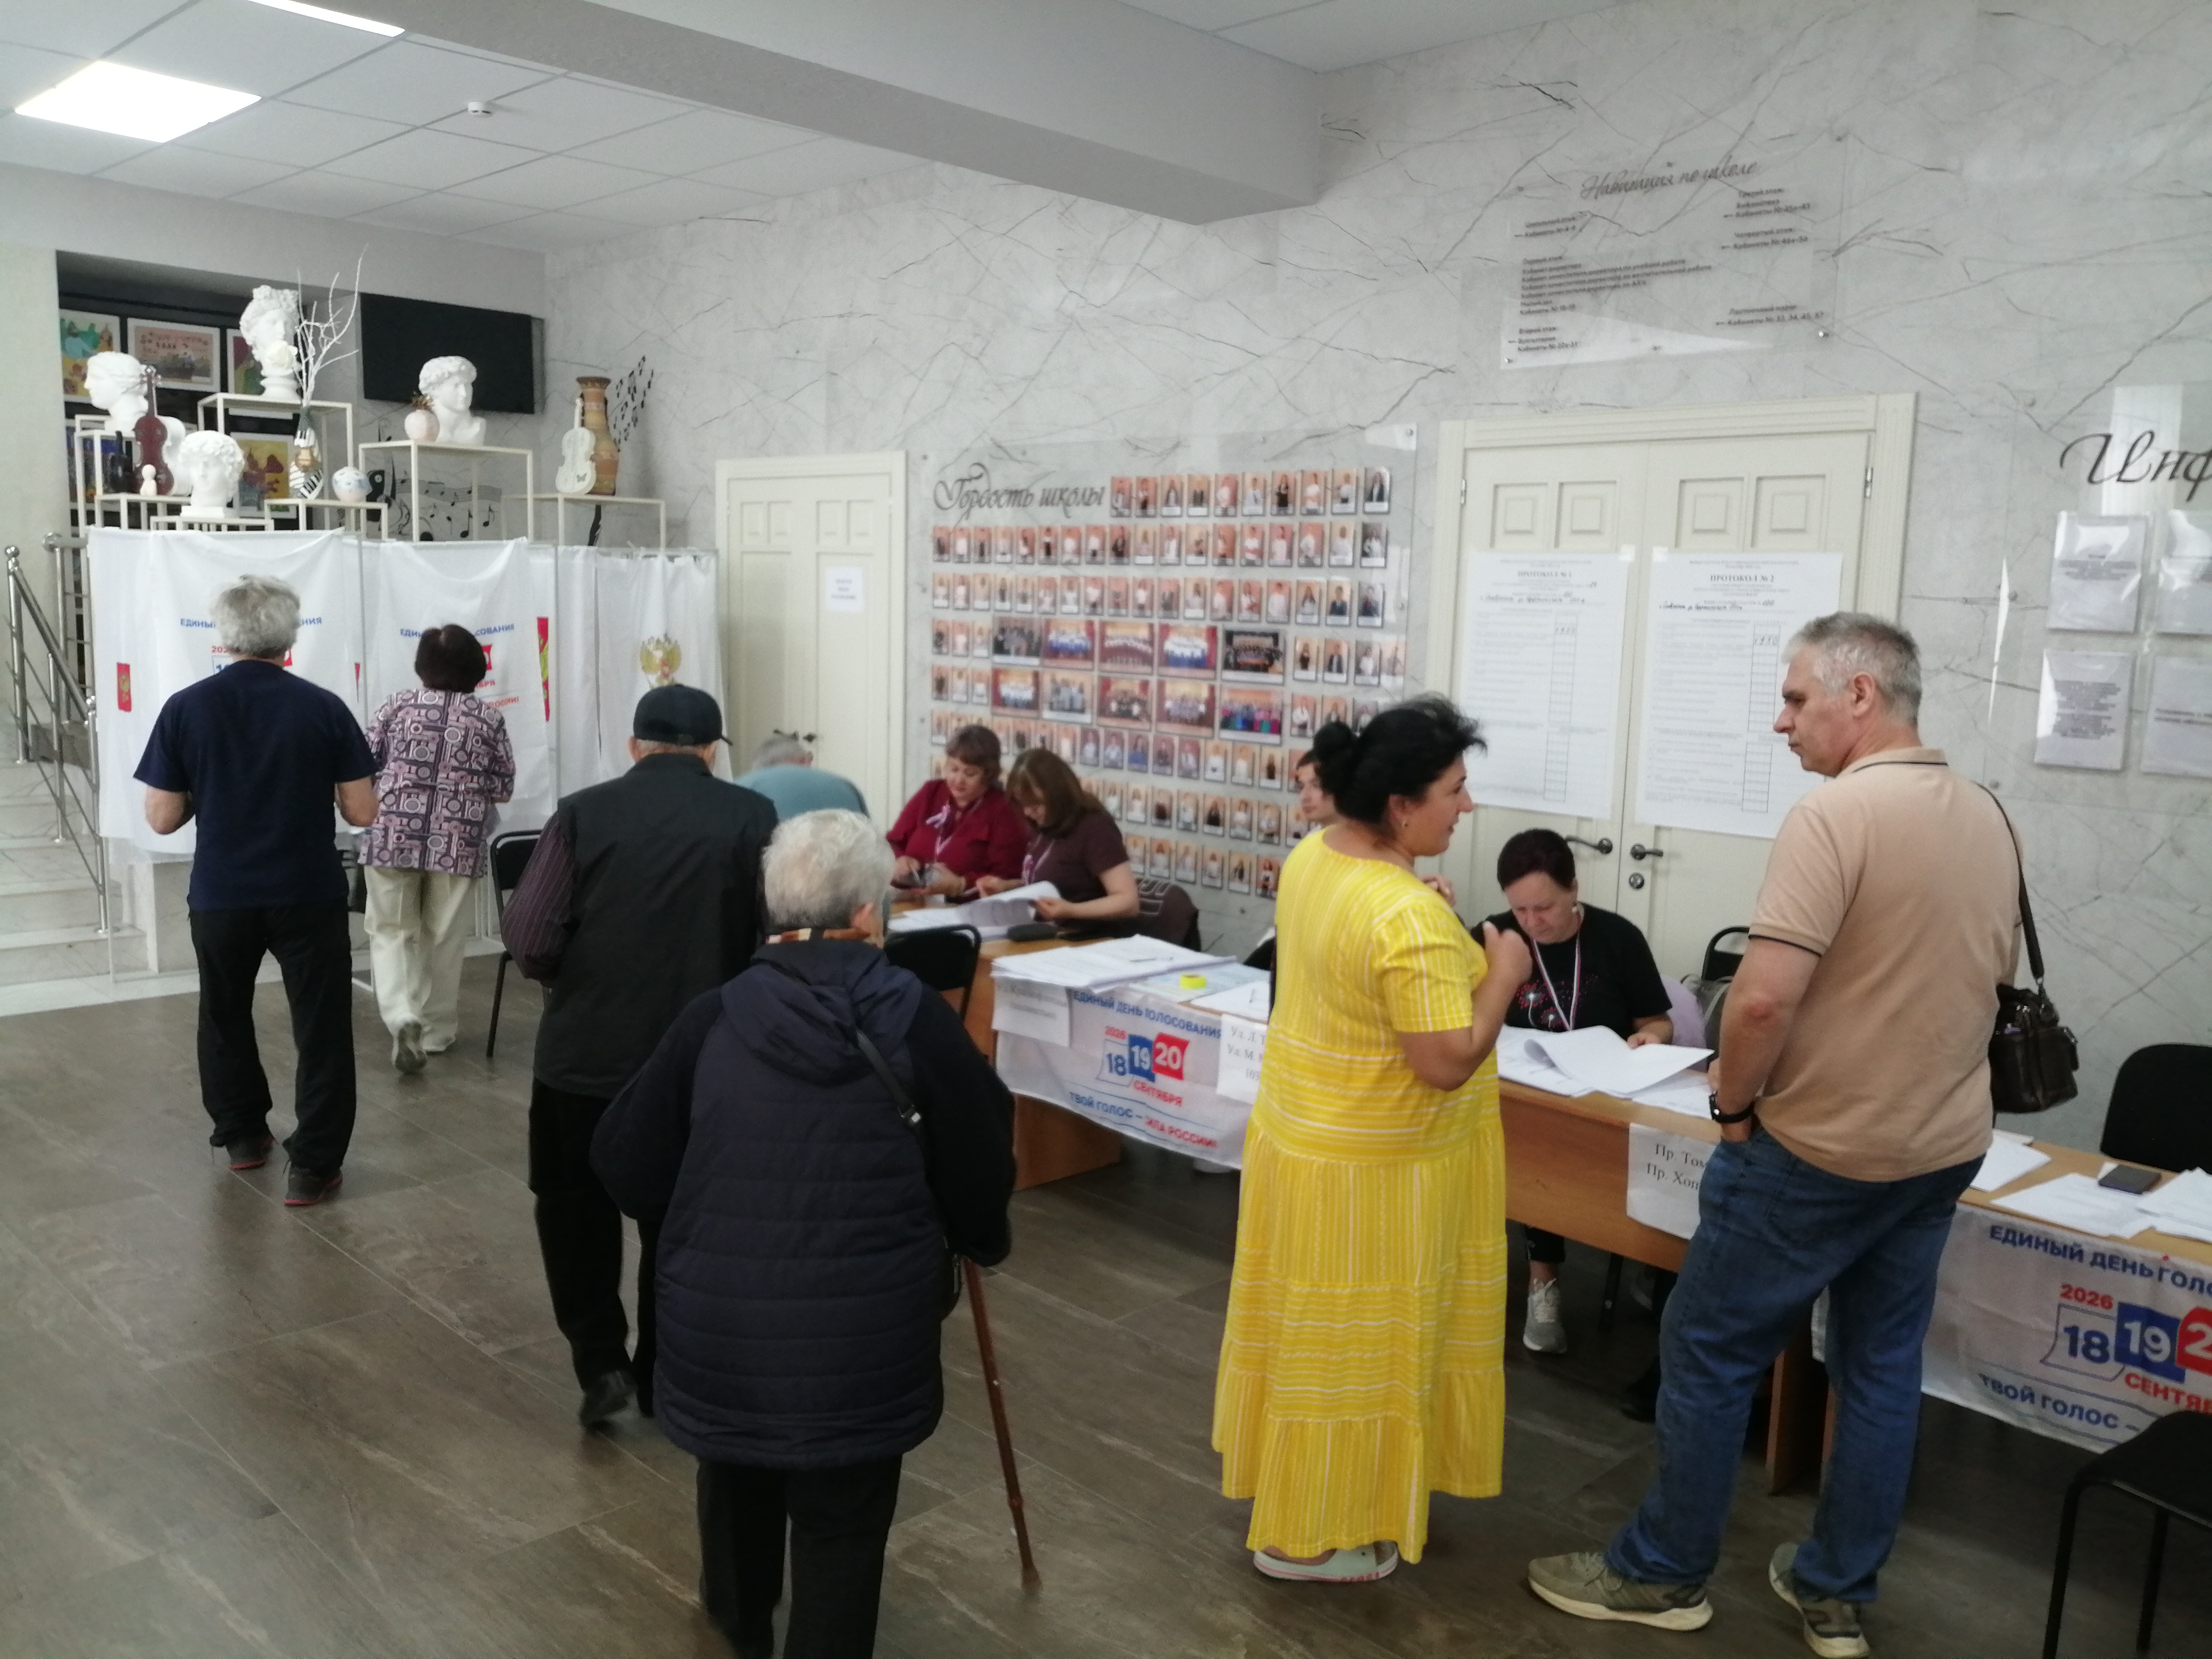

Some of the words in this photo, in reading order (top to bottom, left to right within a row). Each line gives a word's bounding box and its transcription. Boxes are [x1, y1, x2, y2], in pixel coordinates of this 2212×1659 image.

[1678, 169, 1699, 184] по
[933, 462, 1035, 520] Гордость
[1038, 485, 1106, 520] школы
[180, 618, 216, 629] ЕДИНЫ
[1116, 1000, 1143, 1017] ДЕНЬ
[1107, 1052, 1127, 1076] 18
[1131, 1045, 1151, 1070] 19
[1155, 1042, 1182, 1070] 20
[1069, 1091, 1094, 1109] ТВОЙ
[1096, 1101, 1133, 1118] ГОЛОС
[1133, 1079, 1183, 1108] СЕНТЯБРЯ
[1646, 1162, 1668, 1182] Пр.
[1989, 1224, 2084, 1263] ЕДИНЫЙ
[2089, 1251, 2154, 1278] ДЕНЬ
[2059, 1283, 2115, 1312] 2026
[2063, 1324, 2112, 1365] 18
[2123, 1320, 2172, 1363] 19
[1978, 1372, 2036, 1405] ТВОЙ
[2041, 1394, 2121, 1430] ГОЛОС
